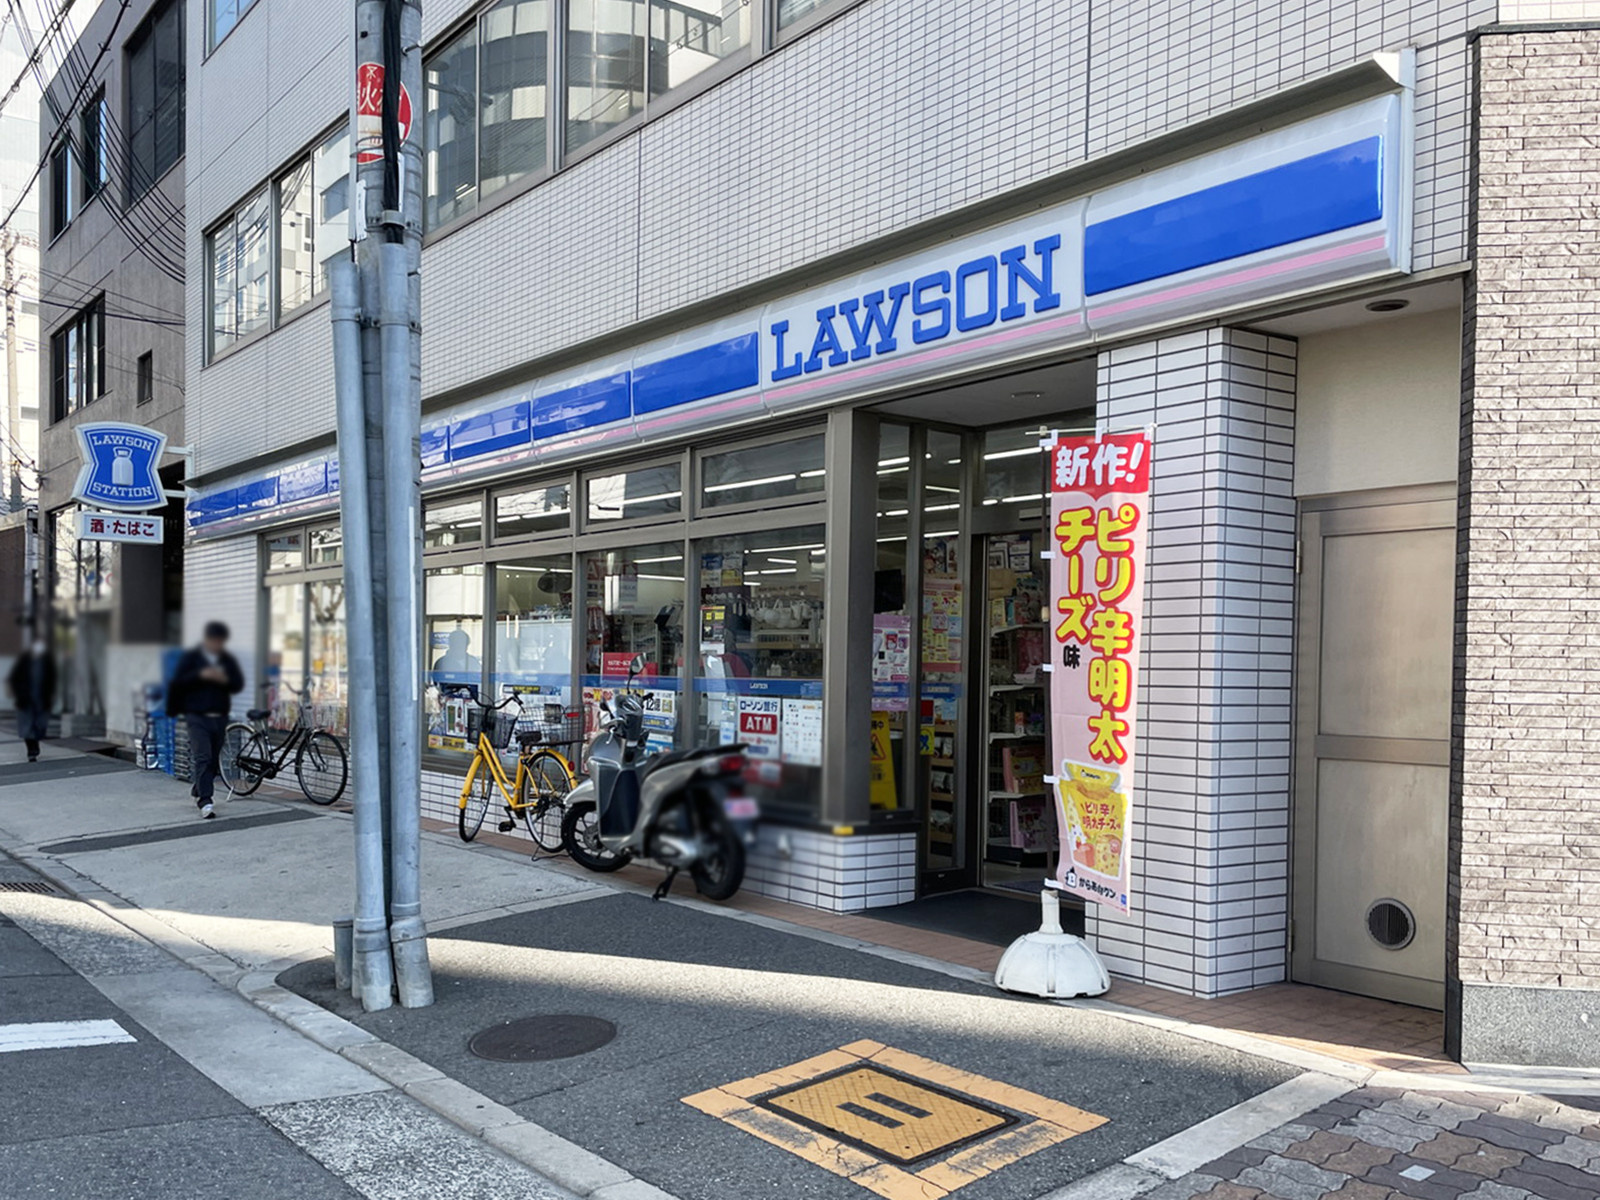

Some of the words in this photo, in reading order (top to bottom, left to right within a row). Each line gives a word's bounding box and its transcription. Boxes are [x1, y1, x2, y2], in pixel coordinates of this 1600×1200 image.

[770, 233, 1061, 382] LAWSON
[92, 434, 153, 451] LAWSON
[1055, 442, 1144, 487] 新作!
[92, 482, 153, 498] STATION
[90, 518, 155, 537] 酒・たばこ
[1087, 502, 1140, 765] ピリ辛明太
[740, 700, 778, 713] ローソン銀行
[745, 716, 772, 732] ATM
